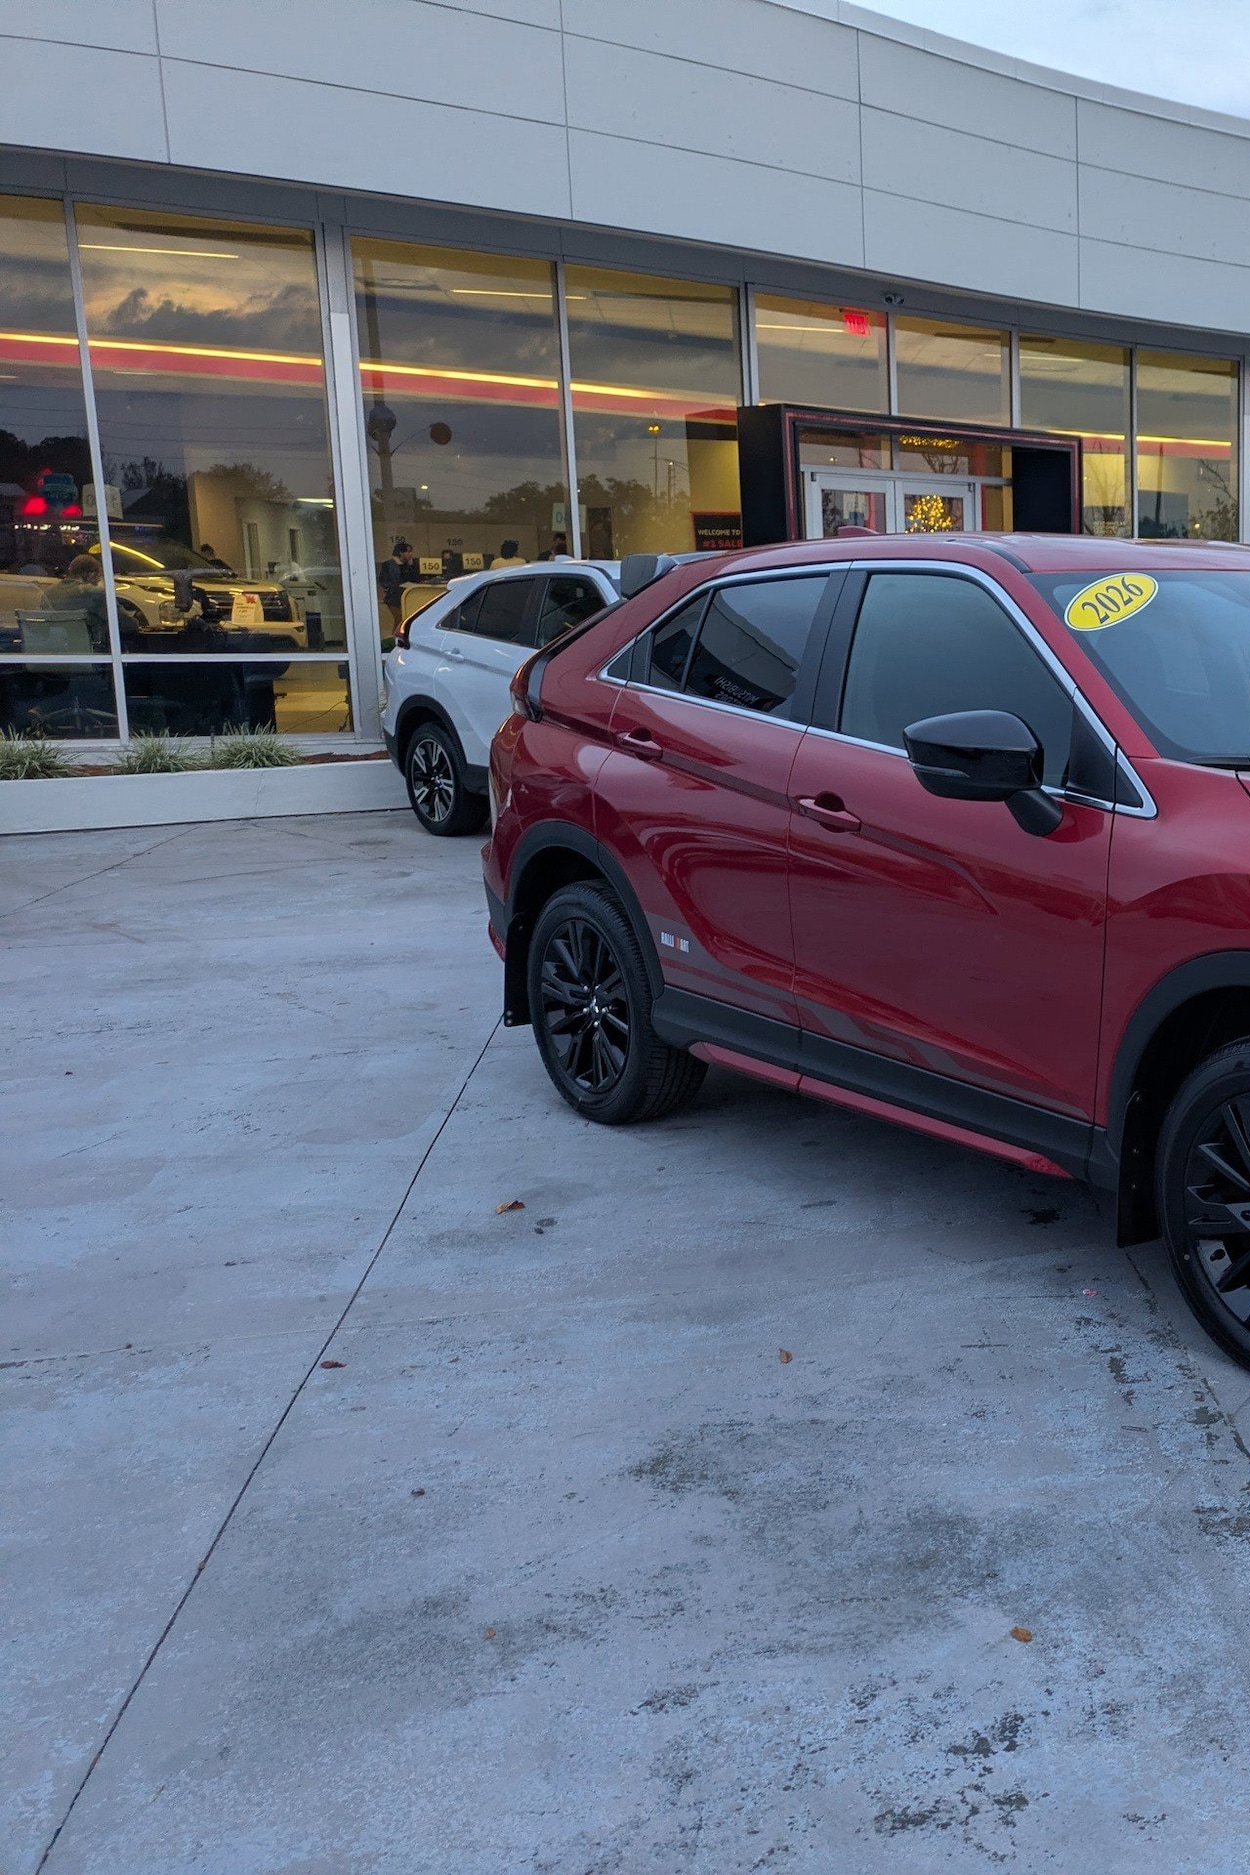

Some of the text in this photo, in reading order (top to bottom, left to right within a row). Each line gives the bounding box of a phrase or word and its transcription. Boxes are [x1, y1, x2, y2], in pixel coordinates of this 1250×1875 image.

[697, 528, 731, 537] WELCOME
[422, 562, 440, 572] 150
[465, 557, 482, 567] 150
[1081, 576, 1144, 625] 2026
